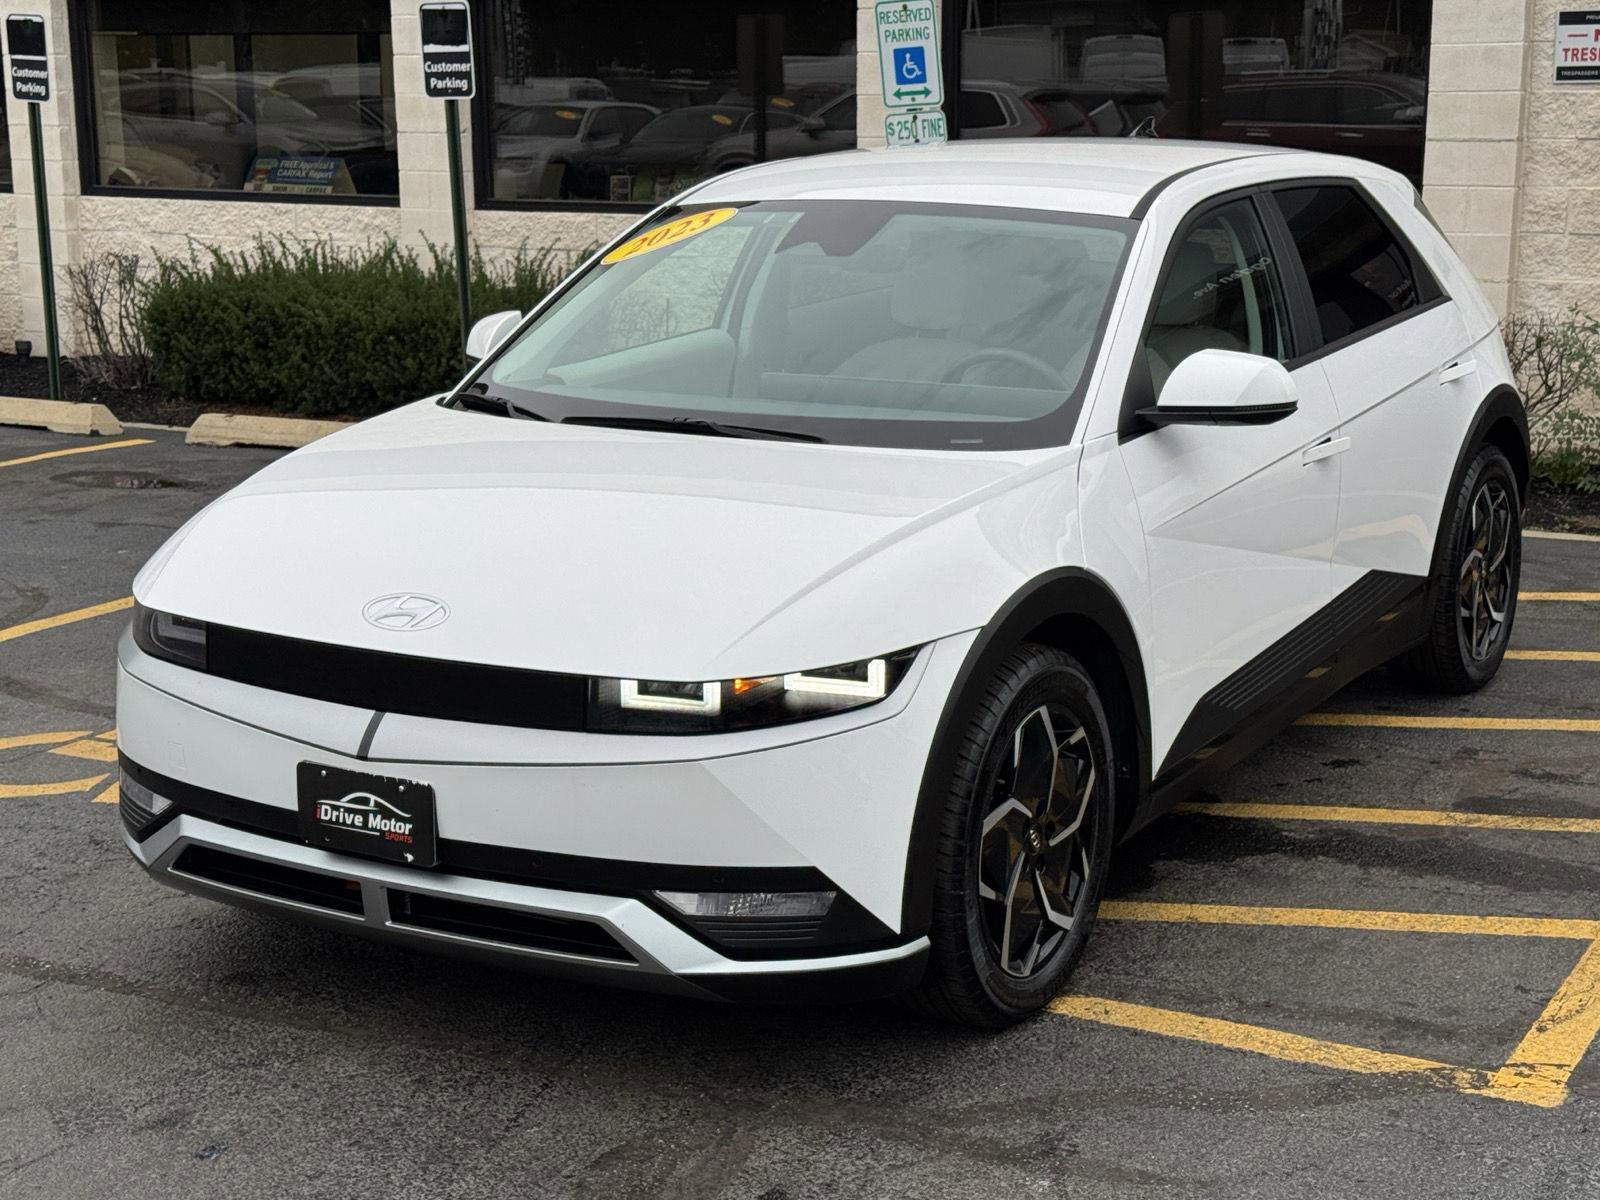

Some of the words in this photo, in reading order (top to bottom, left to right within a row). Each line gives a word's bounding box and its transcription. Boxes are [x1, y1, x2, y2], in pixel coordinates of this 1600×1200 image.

[879, 8, 931, 25] RESERVED
[885, 26, 930, 42] PARKING
[1562, 47, 1600, 62] TRES
[12, 66, 48, 79] Customer
[424, 61, 472, 72] Customer
[16, 82, 46, 96] Parking
[430, 77, 468, 91] Parking
[922, 118, 944, 138] FINE
[280, 161, 298, 169] FREE
[277, 169, 308, 178] CARFAX
[622, 213, 715, 257] 2023
[316, 804, 363, 827] iDrive
[368, 813, 413, 835] Motor
[384, 832, 413, 843] SPORTS
